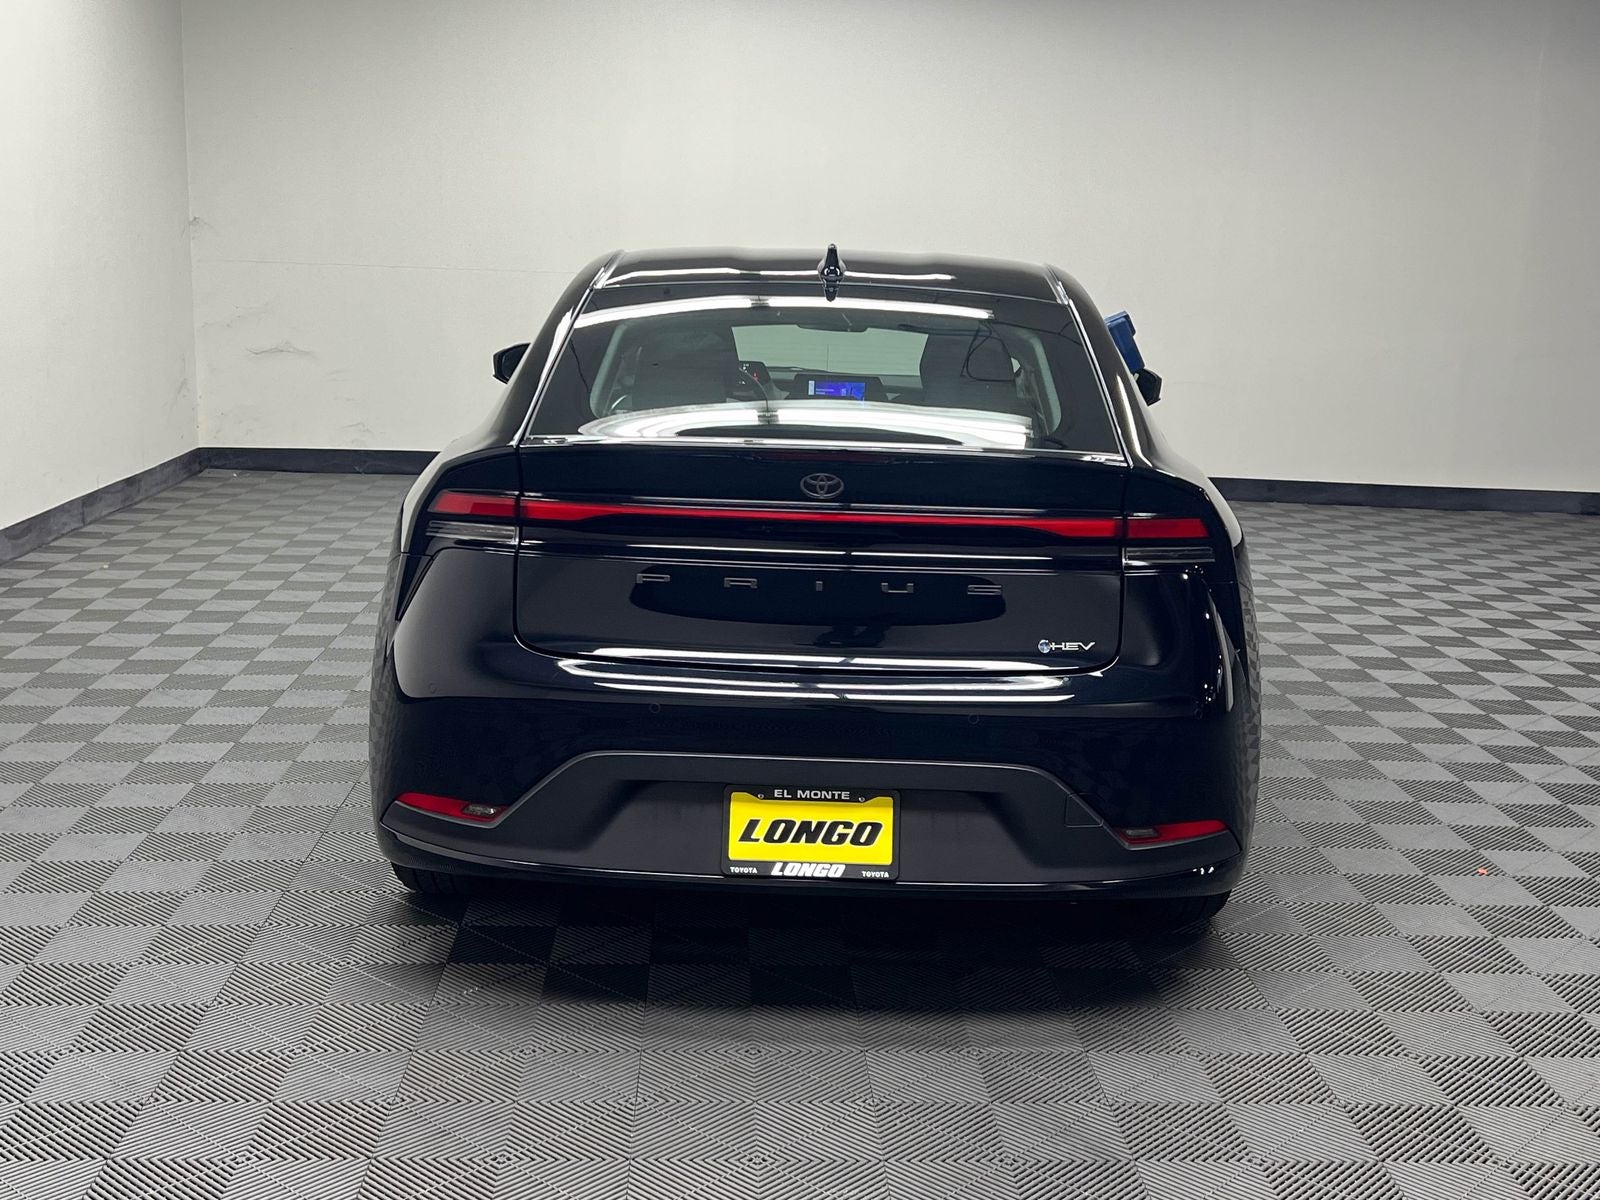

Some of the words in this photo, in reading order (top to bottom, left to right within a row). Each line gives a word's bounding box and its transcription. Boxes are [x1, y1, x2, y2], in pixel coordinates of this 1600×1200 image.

[636, 573, 1002, 595] PRIUS
[1048, 641, 1096, 652] HEV
[774, 789, 792, 798] EL
[797, 790, 850, 800] MONTE
[738, 819, 883, 846] LONGO
[729, 866, 758, 874] TOYOTA
[770, 862, 846, 878] LONGO
[861, 870, 890, 878] TOYOTA
